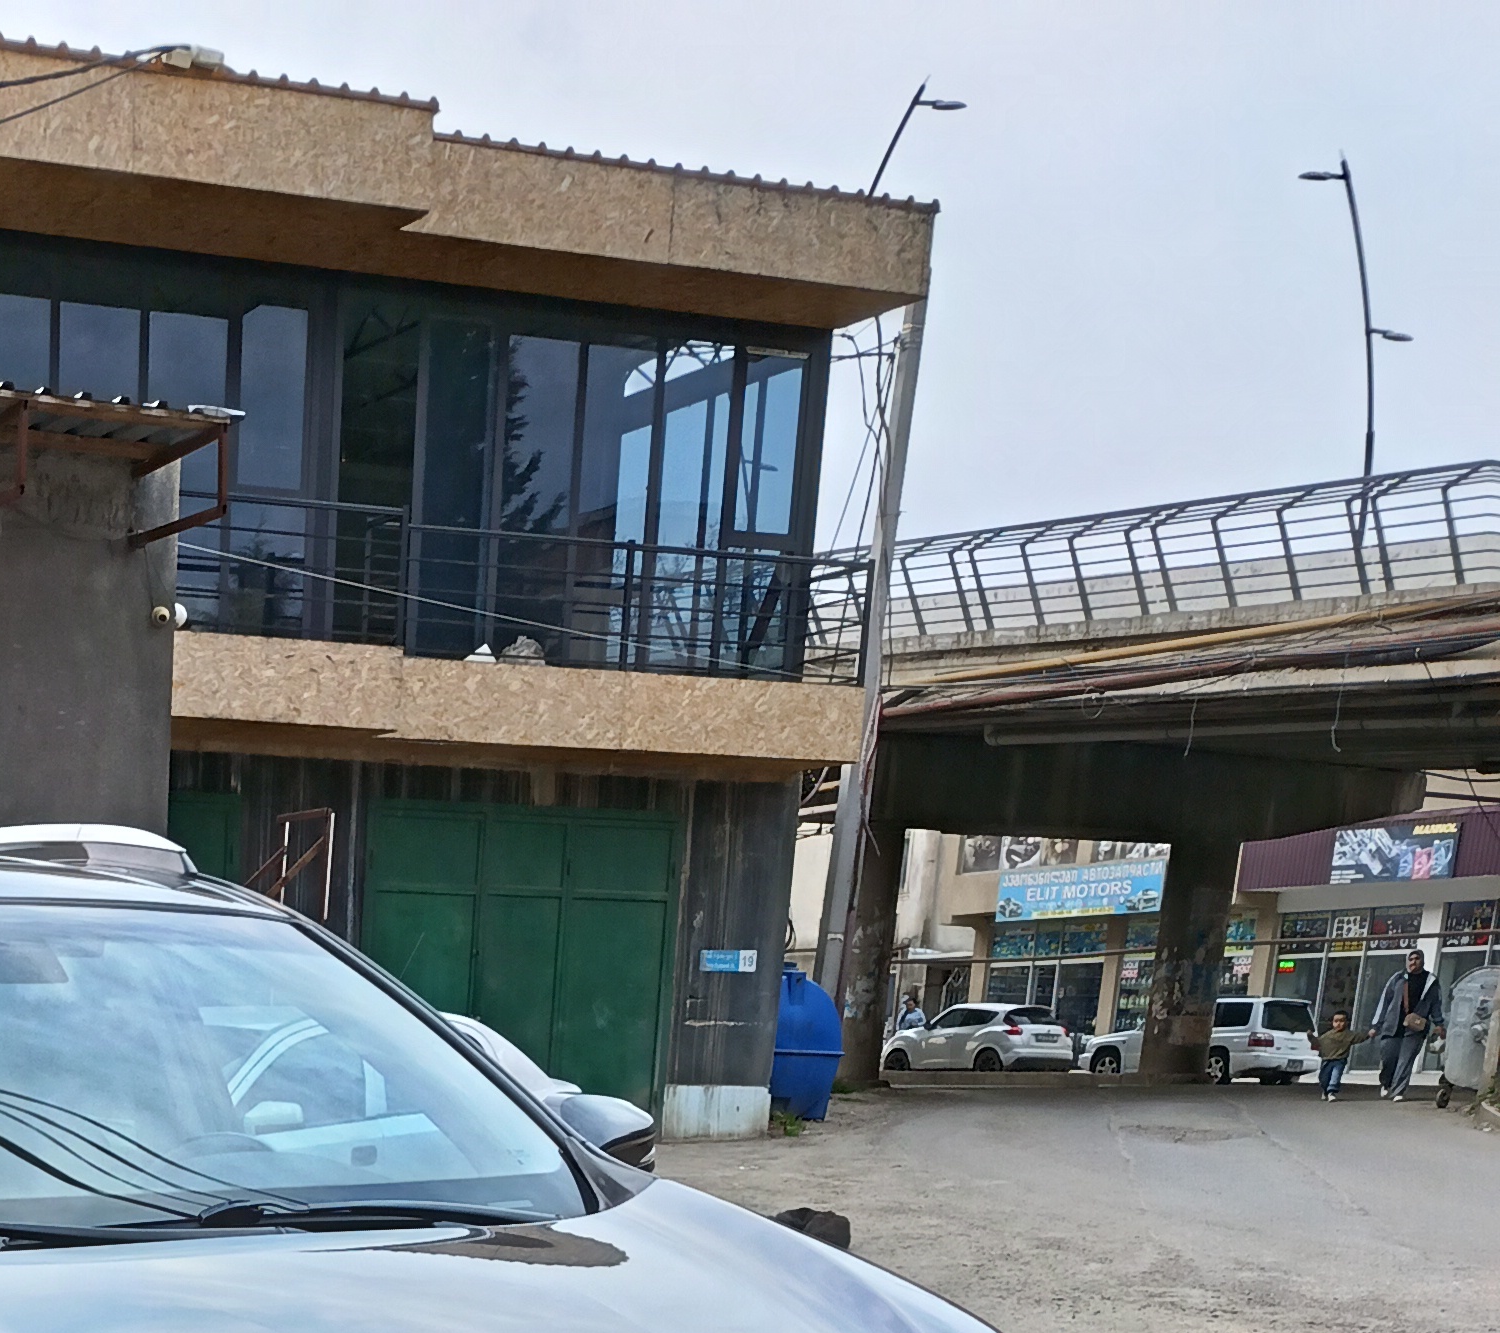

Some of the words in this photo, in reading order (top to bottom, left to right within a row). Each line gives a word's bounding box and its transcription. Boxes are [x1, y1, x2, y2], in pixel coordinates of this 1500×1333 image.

[1026, 886, 1060, 901] ELIT
[1062, 880, 1132, 899] MOTORS
[742, 955, 754, 967] 19
